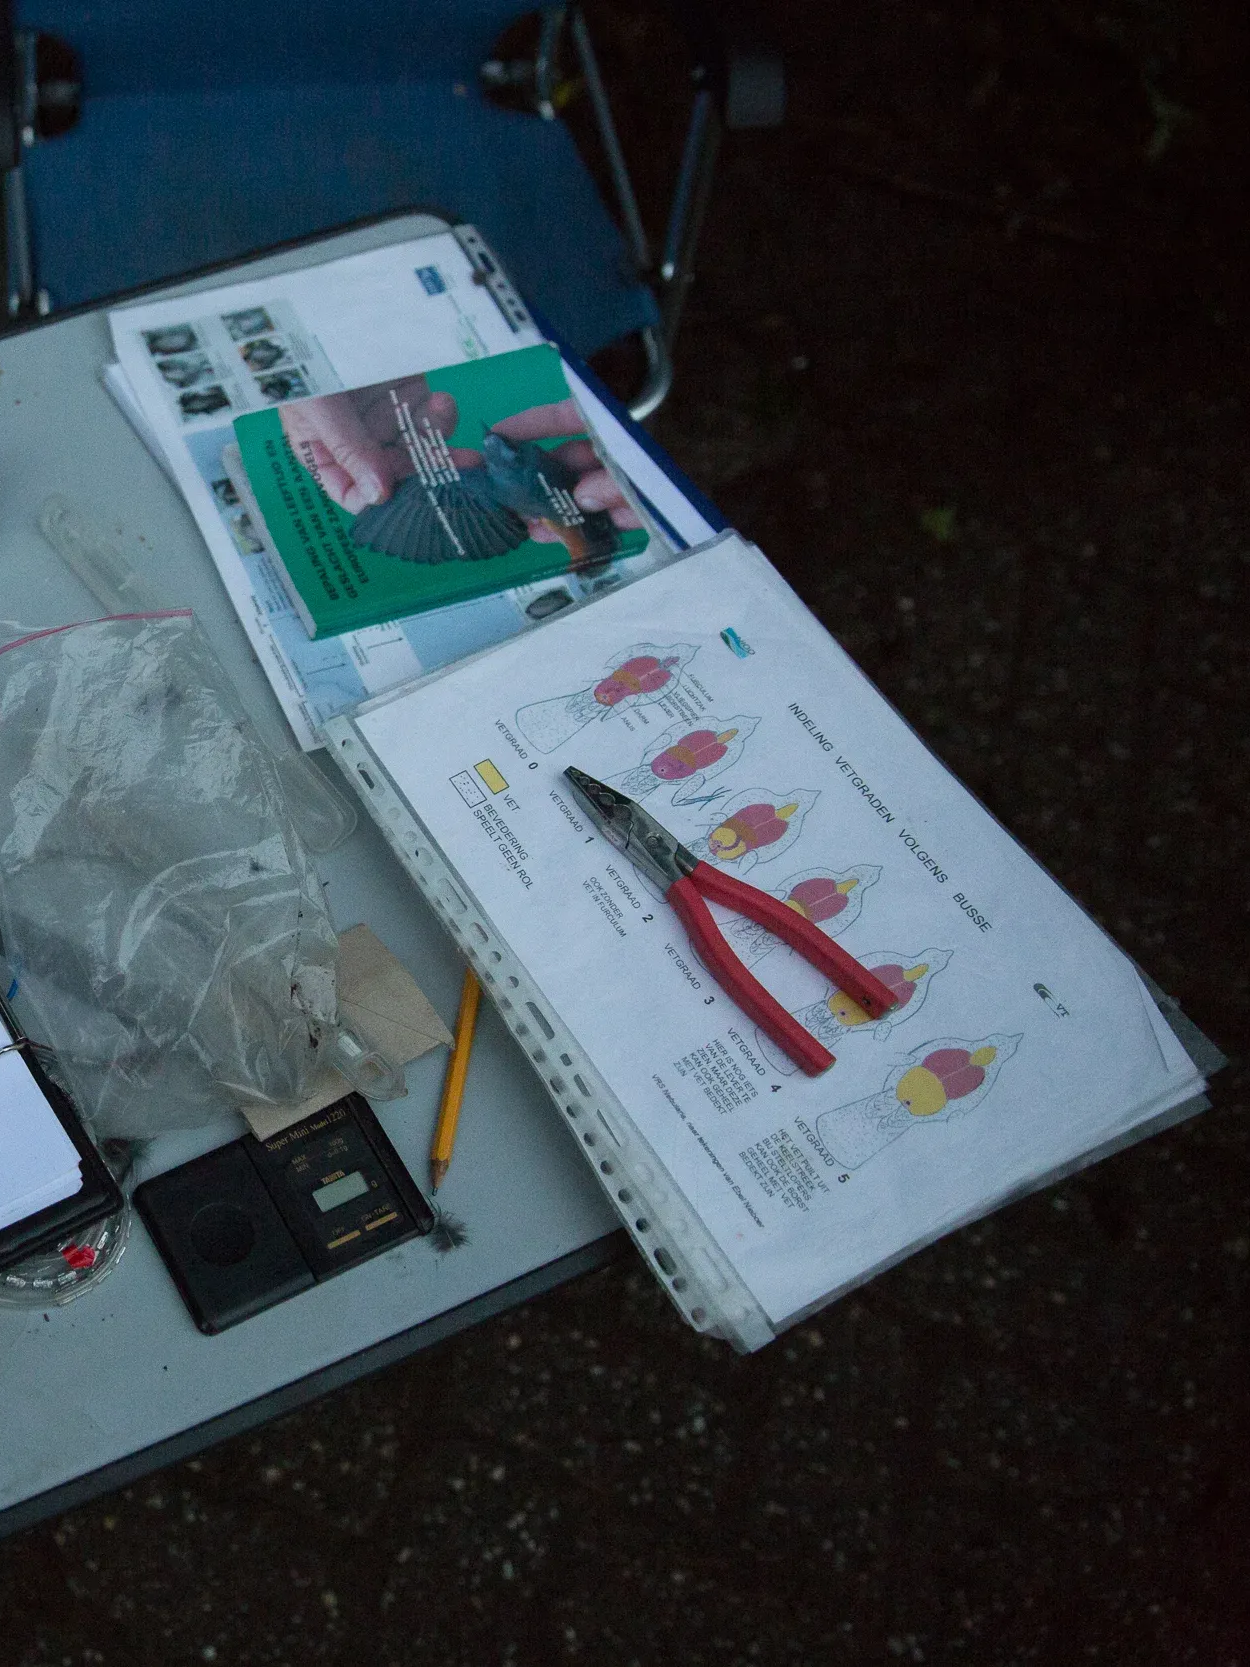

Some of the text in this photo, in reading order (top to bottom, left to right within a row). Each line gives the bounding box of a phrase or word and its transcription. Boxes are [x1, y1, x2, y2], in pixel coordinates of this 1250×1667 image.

[291, 516, 311, 546] VAN
[307, 511, 327, 540] VAN
[331, 520, 370, 586] EUROPESE
[305, 543, 340, 602] BEPALING
[321, 539, 359, 601] GESLACHT
[657, 700, 675, 719] LEVER
[681, 683, 707, 712] LUCHTZAK
[494, 718, 538, 770] VETGRAAD 0
[482, 803, 529, 861] BEVEDERING
[502, 793, 521, 811] VET
[548, 789, 595, 844] VETGRAAD 1
[787, 702, 992, 933] INDELING VETGRADEN VOLGENS BUSSE
[472, 808, 533, 890] SPEELT GEEN ROL
[581, 879, 627, 938] VET IN FURCULUM
[589, 876, 624, 919] OOK ZONDER
[604, 863, 654, 923] VETGRAAD 2
[663, 942, 715, 1005] VETGRAAD 3
[680, 1055, 728, 1116] MET VET BEDEKT
[687, 1051, 736, 1113] KAN OOK GEHEEL
[703, 1042, 752, 1104] VAN DE LEVER TE
[708, 1064, 729, 1088] MAAR
[724, 1085, 743, 1107] DEZE
[711, 1037, 759, 1098] HIER IS NOG IETS
[726, 1026, 782, 1093] VETGRAAD 4
[265, 1136, 291, 1153] Super
[289, 1127, 310, 1141] Mini
[291, 1154, 307, 1165] MAX
[737, 1150, 764, 1182] BEDEKT
[761, 1136, 813, 1202] BIJ STELTLOPERS
[769, 1132, 817, 1192] DE KEELSTREEK
[777, 1127, 830, 1195] HET VET PUILT UIT
[793, 1115, 850, 1183] VETGRAAD 5
[321, 1169, 345, 1185] TANITA
[745, 1145, 796, 1210] GEHEEL MET VET
[753, 1141, 810, 1214] KAN OOK DE BORST
